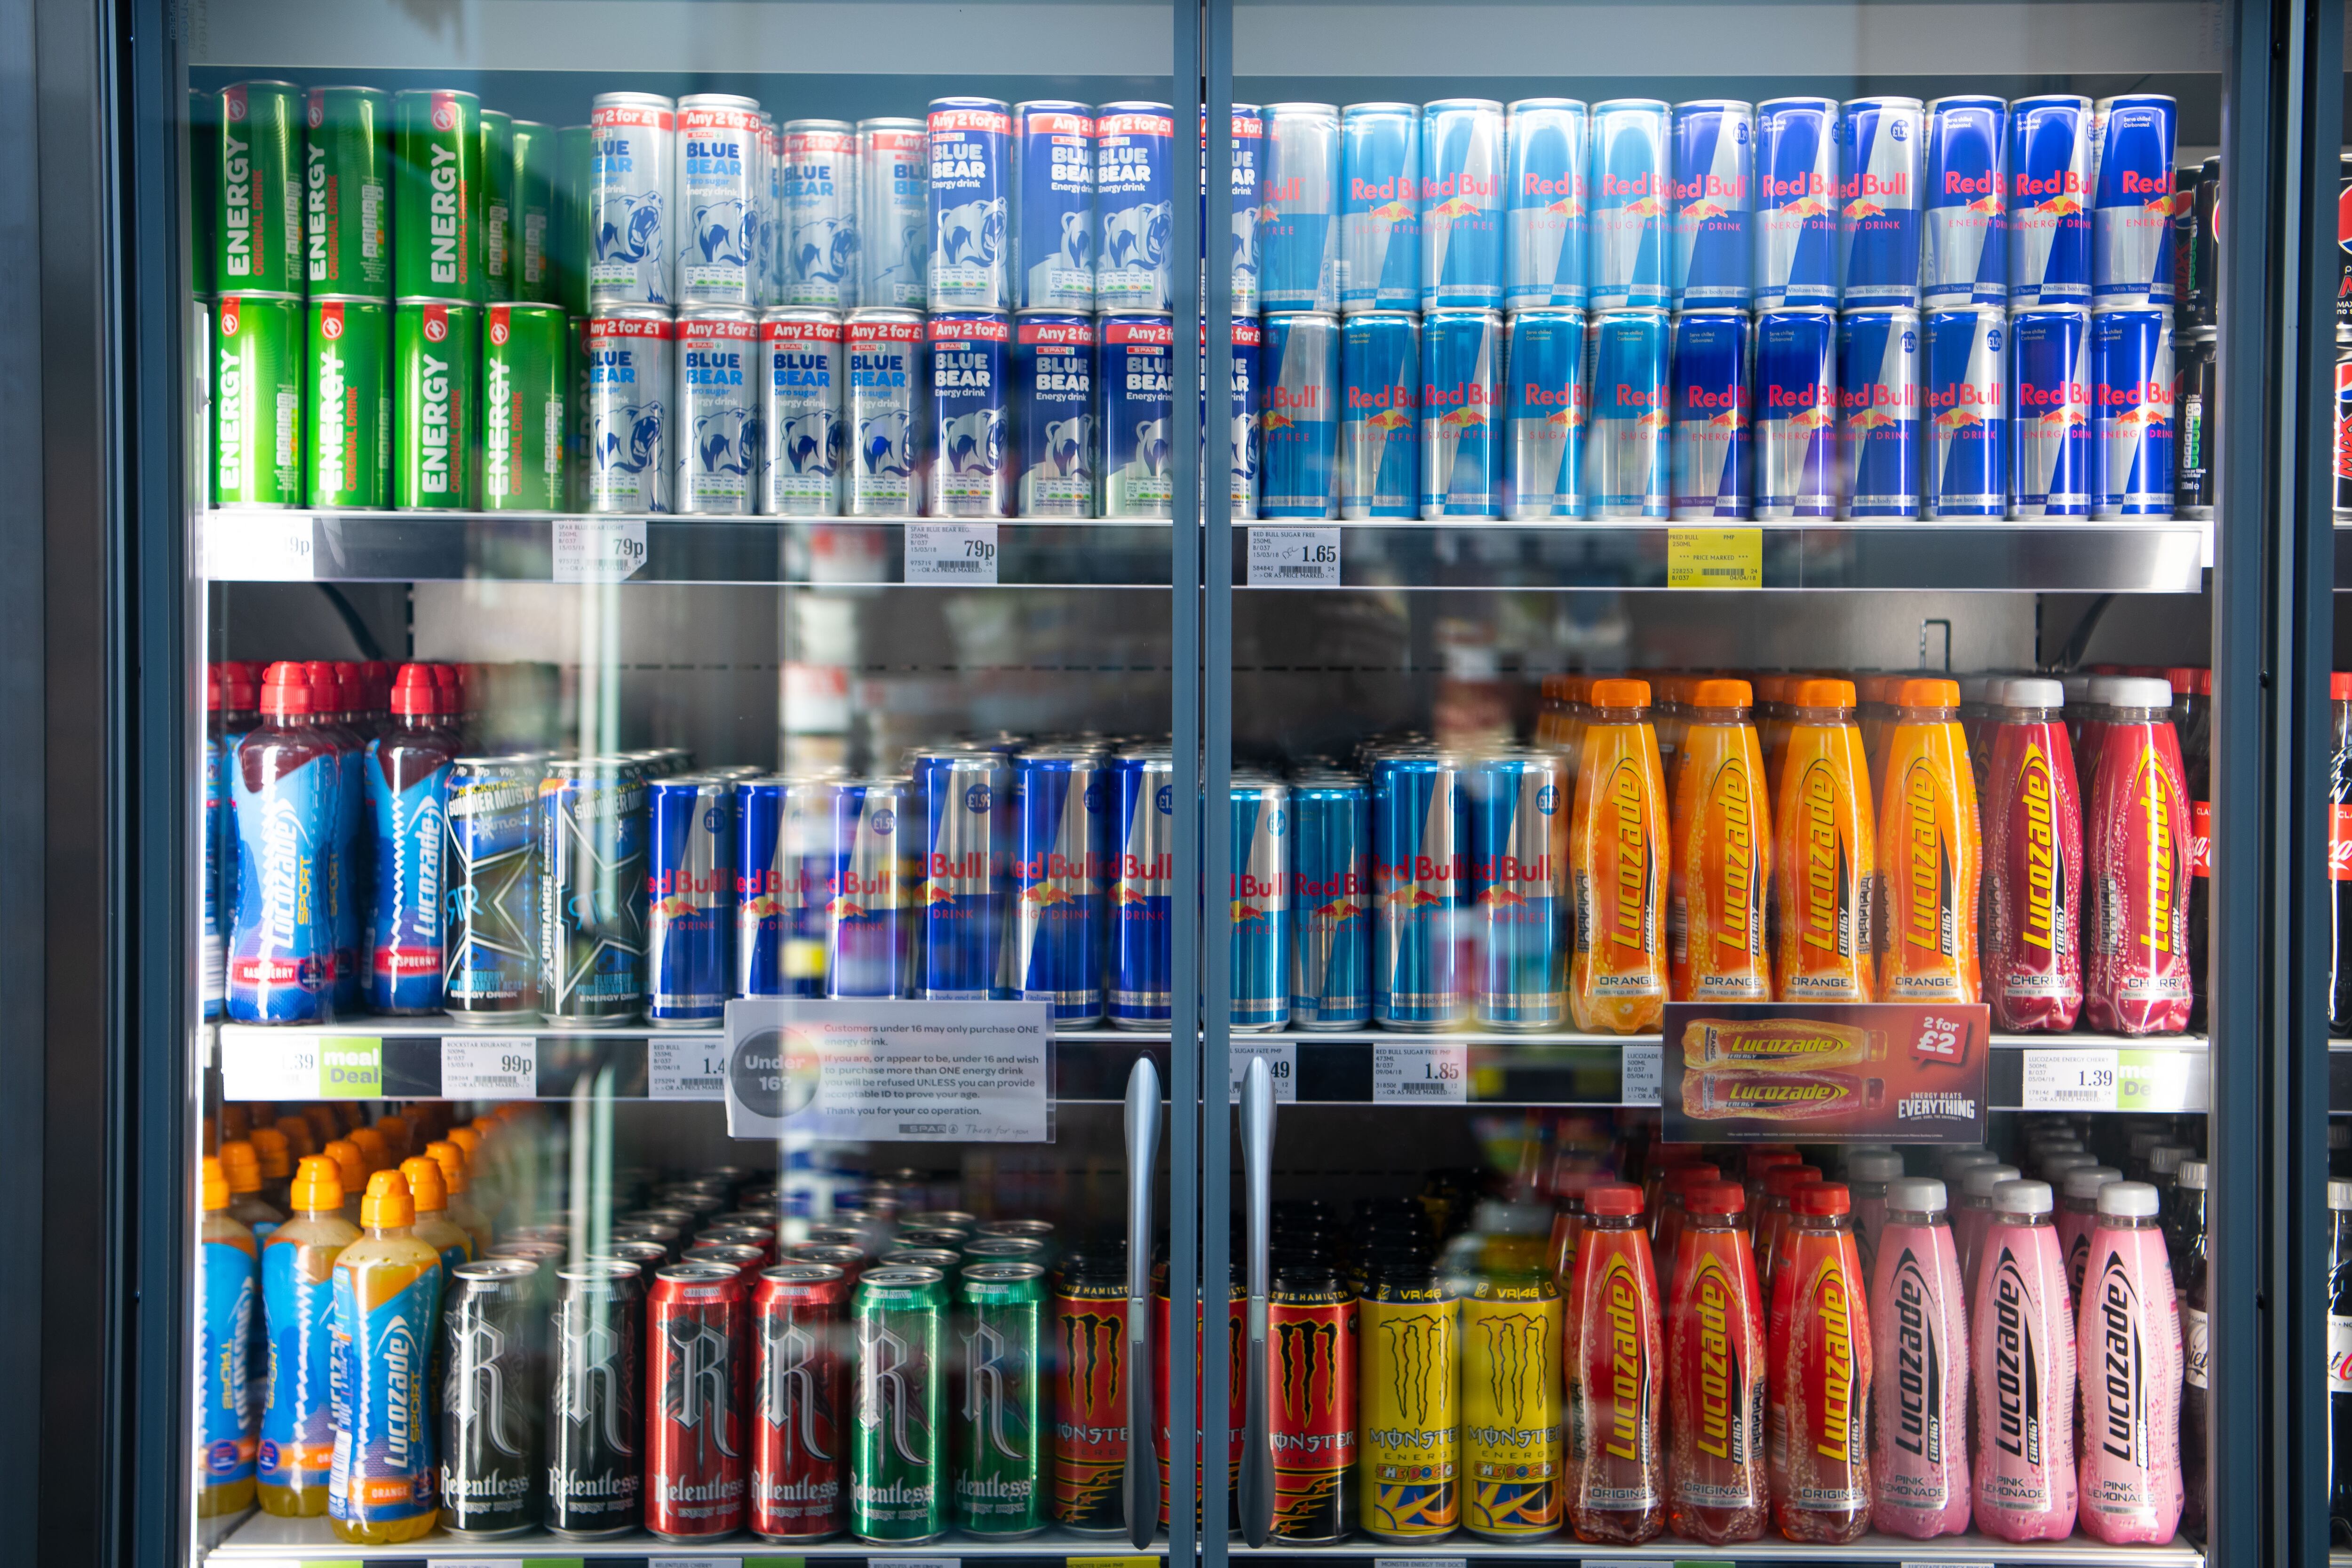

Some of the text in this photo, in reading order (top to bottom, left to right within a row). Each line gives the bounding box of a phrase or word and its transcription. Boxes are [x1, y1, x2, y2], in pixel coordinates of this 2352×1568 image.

[933, 113, 1006, 128] Any 2 for £1
[933, 144, 983, 160] BLUE
[932, 161, 985, 178] BEAR
[932, 179, 980, 189] Energy drink
[1460, 174, 1498, 196] Bull
[1863, 172, 1907, 195] Bull
[1946, 170, 1991, 193] Red
[227, 135, 250, 275] ENERGY
[430, 143, 456, 283] ENERGY
[1949, 219, 1993, 228] ENERGY
[936, 323, 1007, 337] Any 2 for £1
[1987, 337, 2001, 348] £1.29
[935, 353, 988, 369] BLUE
[935, 371, 990, 387] BEAR
[935, 389, 961, 398] Energy
[1960, 383, 2000, 405] Bull
[422, 354, 448, 493] ENERGY
[488, 358, 510, 496] ENERGY
[346, 386, 358, 491] ORIGINAL DRINK
[1963, 430, 1995, 439] DRINK
[613, 539, 643, 558] 79p
[965, 541, 994, 560] 79p
[1303, 546, 1336, 562] 1.65
[931, 852, 981, 878] Bull
[1717, 777, 1749, 952] Lucozade
[1804, 777, 1848, 957] Lucozade ENERGY
[1907, 775, 1953, 956] Lucozade ENERGY
[2023, 774, 2065, 955] Lucozade ENERGY
[413, 810, 443, 937] Lucozade
[297, 855, 312, 925] SPORT
[1295, 873, 1338, 896] Red
[1126, 910, 1164, 920] DRINK
[1792, 977, 1848, 987] ORANGE
[1895, 976, 1953, 987] ORANGE
[924, 1027, 945, 1035] may
[947, 1026, 967, 1035] only
[970, 1027, 1015, 1035] purchase
[1923, 1017, 1959, 1032] 2 for
[1732, 1036, 1833, 1052] Lucozade
[1917, 1030, 1955, 1054] £2
[324, 1048, 379, 1067] meal
[502, 1054, 532, 1074] 99p
[745, 1056, 805, 1069] Under
[330, 1068, 379, 1084] Deal
[839, 1067, 884, 1076] purchase
[1425, 1063, 1458, 1079] 1.85
[2079, 1070, 2112, 1086] 1.39
[760, 1077, 791, 1091] 16?
[1730, 1083, 1831, 1100] Lucozade
[931, 1108, 981, 1116] operation.
[1899, 1099, 1974, 1119] EVERYTHING
[1299, 1290, 1348, 1301] HAMILTON
[1698, 1283, 1743, 1464] Lucozade ENERGY
[1818, 1285, 1850, 1462] Lucozade
[1895, 1279, 1939, 1463] Lucozade ENERGY
[1994, 1280, 2040, 1464] Lucozade ENERGY
[384, 1329, 420, 1468] Lucozade SPORT
[1385, 1450, 1455, 1460] ENERGY
[1376, 1465, 1407, 1479] THE
[549, 1460, 638, 1509] Relentless
[1895, 1475, 1923, 1486] PINK
[1997, 1476, 2024, 1485] PINK
[372, 1486, 407, 1499] ORANGE
[654, 1472, 743, 1515] Relentless
[1684, 1482, 1745, 1496] ORIGINAL
[1981, 1484, 2045, 1498] LEMONADE
